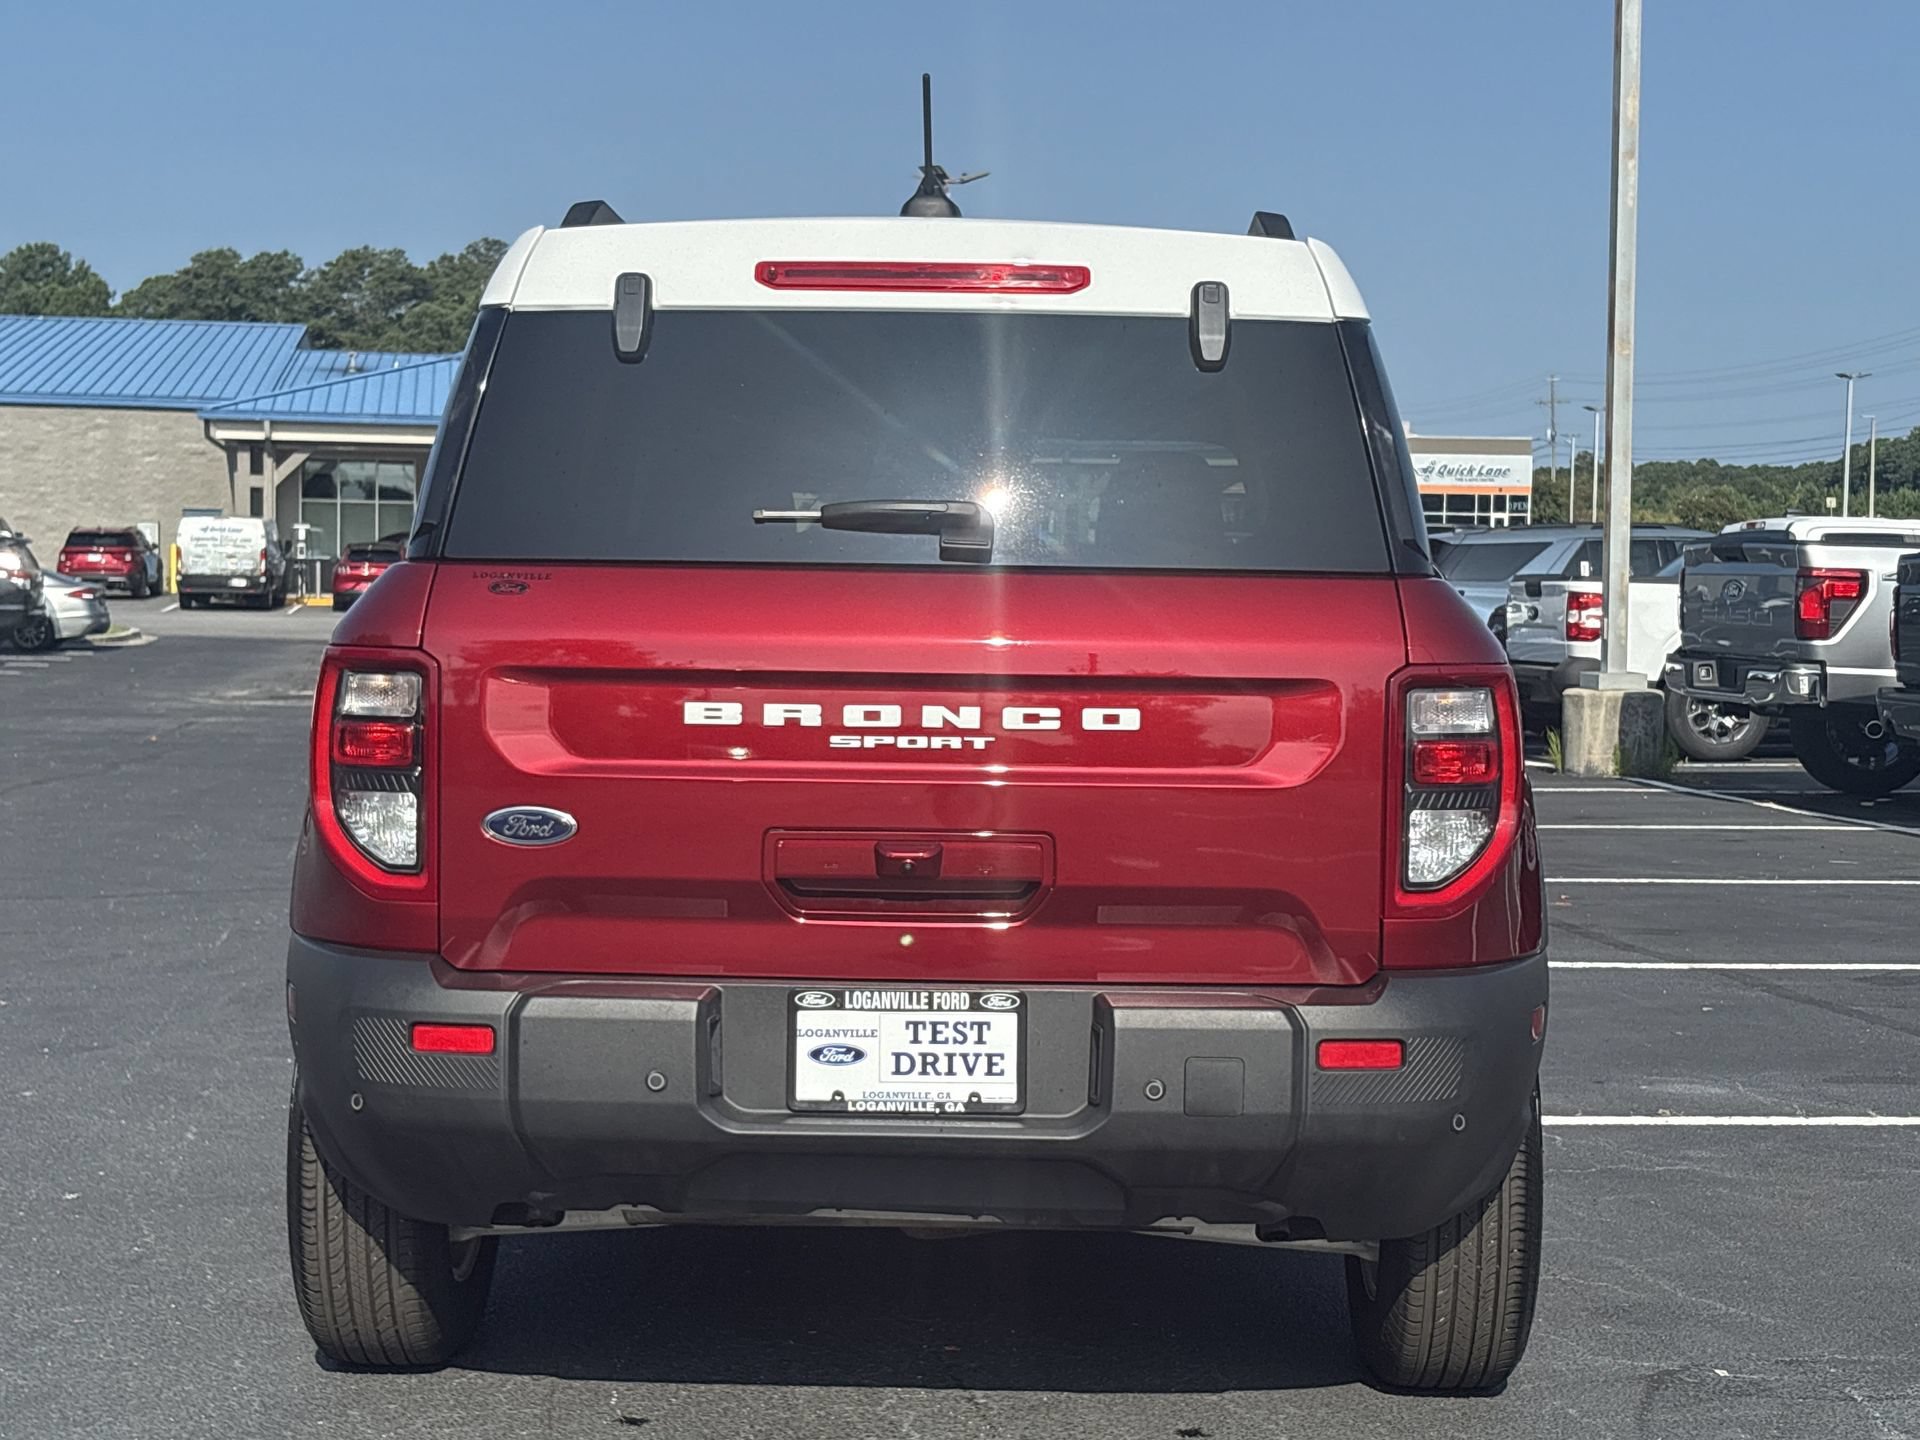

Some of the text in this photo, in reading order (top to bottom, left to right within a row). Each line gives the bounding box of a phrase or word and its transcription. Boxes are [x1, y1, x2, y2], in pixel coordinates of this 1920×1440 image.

[1436, 464, 1511, 478] Quick Lane
[472, 571, 552, 580] LOGANVILLE
[683, 701, 1141, 731] BRONCO
[829, 735, 995, 750] SPORT
[503, 813, 555, 837] Ford
[801, 993, 828, 1006] Ford
[844, 991, 970, 1010] LOGANVILLE FORD
[986, 995, 1013, 1008] Ford
[797, 1028, 878, 1038] LOGANVILLE
[905, 1020, 991, 1045] TEST
[818, 1046, 854, 1063] Ford
[890, 1052, 1005, 1077] DRIVE
[862, 1091, 951, 1101] LOGANVILLE, GA
[847, 1101, 965, 1114] LOGANVILLE, GA
